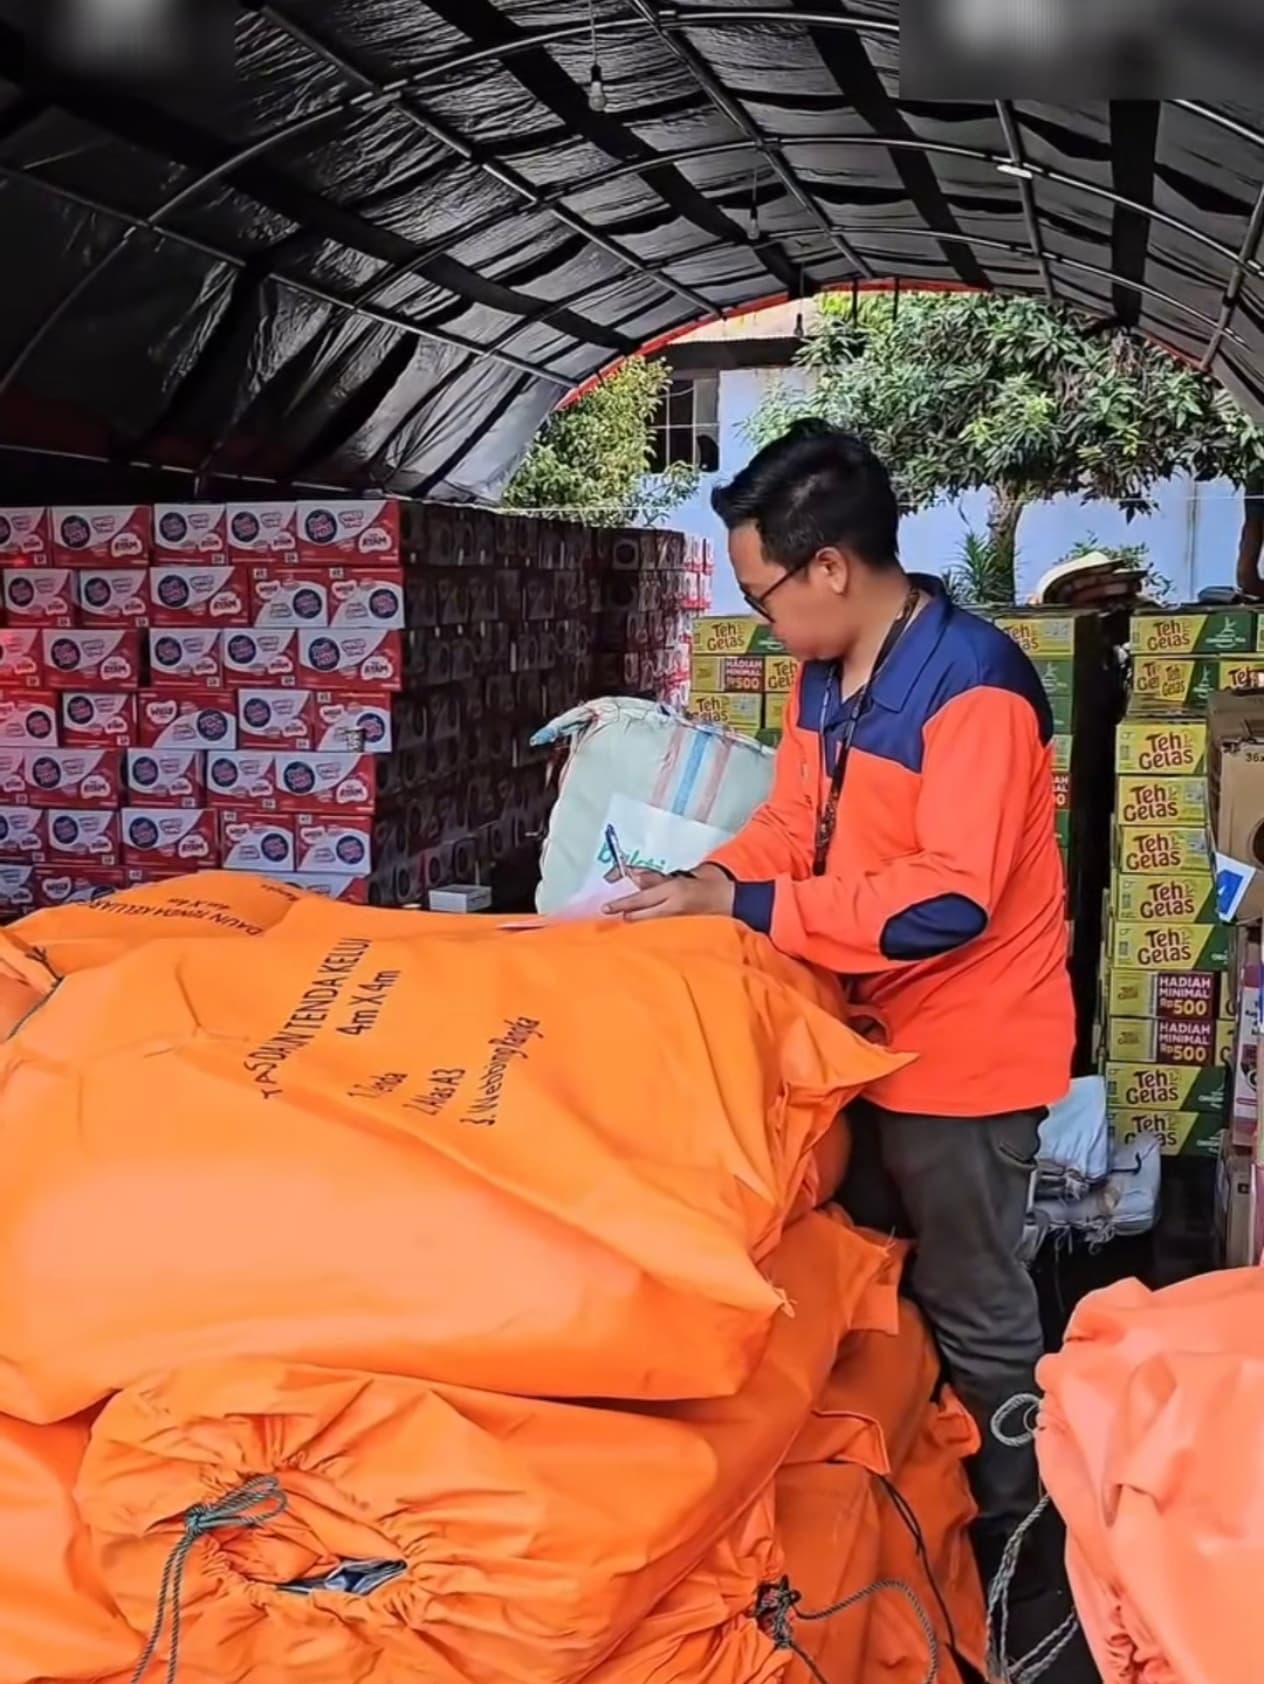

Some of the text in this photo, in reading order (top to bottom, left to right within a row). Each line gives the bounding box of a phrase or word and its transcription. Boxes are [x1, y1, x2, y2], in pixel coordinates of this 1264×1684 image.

[712, 622, 737, 638] Teh
[1153, 620, 1180, 637] Teh
[707, 635, 745, 651] Gelas
[1147, 633, 1190, 650] Gelas
[696, 696, 721, 712] Teh
[1146, 732, 1181, 753] Teh
[1139, 749, 1193, 770] Gelas
[1130, 784, 1166, 804] Teh
[1123, 801, 1178, 822] Gelas
[1133, 834, 1169, 853] Teh
[1126, 851, 1181, 870] Gelas
[1147, 880, 1183, 902] Teh
[1140, 899, 1195, 919] Gelas
[1144, 928, 1180, 949] Teh
[1137, 945, 1192, 965] Gelas
[357, 970, 402, 992] 4m
[1160, 976, 1211, 989] HADIAH
[1160, 987, 1210, 999] MINIMAL
[336, 1009, 379, 1035] 4m
[1160, 1022, 1211, 1034] HADIAH
[243, 1060, 283, 1100] TAS
[283, 976, 350, 1029] TENDA
[1160, 1033, 1210, 1046] MINIMAL
[1133, 1070, 1168, 1088] Teh
[1126, 1087, 1179, 1105] Gelas
[1131, 1114, 1166, 1133] Teh
[1124, 1131, 1177, 1147] Gas
